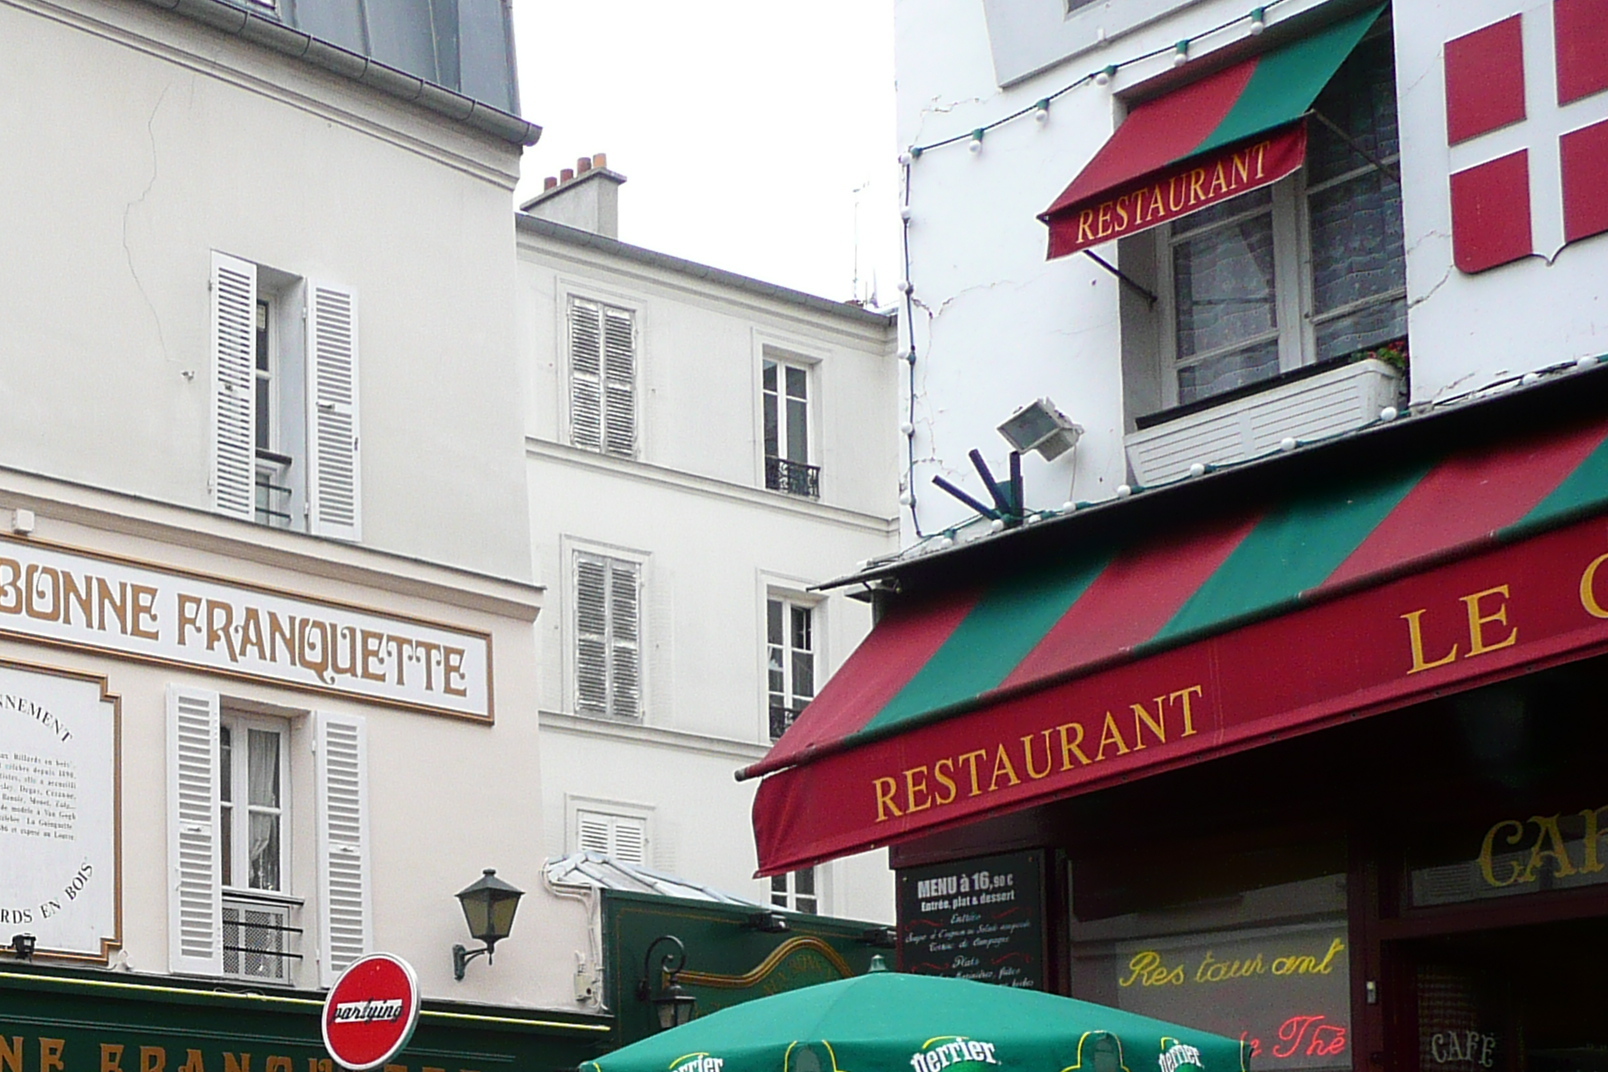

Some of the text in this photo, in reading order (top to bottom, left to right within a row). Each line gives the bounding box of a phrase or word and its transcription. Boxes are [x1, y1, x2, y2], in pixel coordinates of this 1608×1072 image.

[1076, 140, 1271, 244] RESTAURANT
[177, 592, 468, 698] FRANQUETTE
[1400, 584, 1518, 675] LE
[872, 685, 1204, 823] RESTAURANT
[40, 899, 61, 920] EN
[64, 861, 93, 902] BOIS
[918, 876, 957, 898] MENU
[960, 874, 969, 893] à
[952, 896, 971, 909] plat
[980, 890, 1015, 904] dessert
